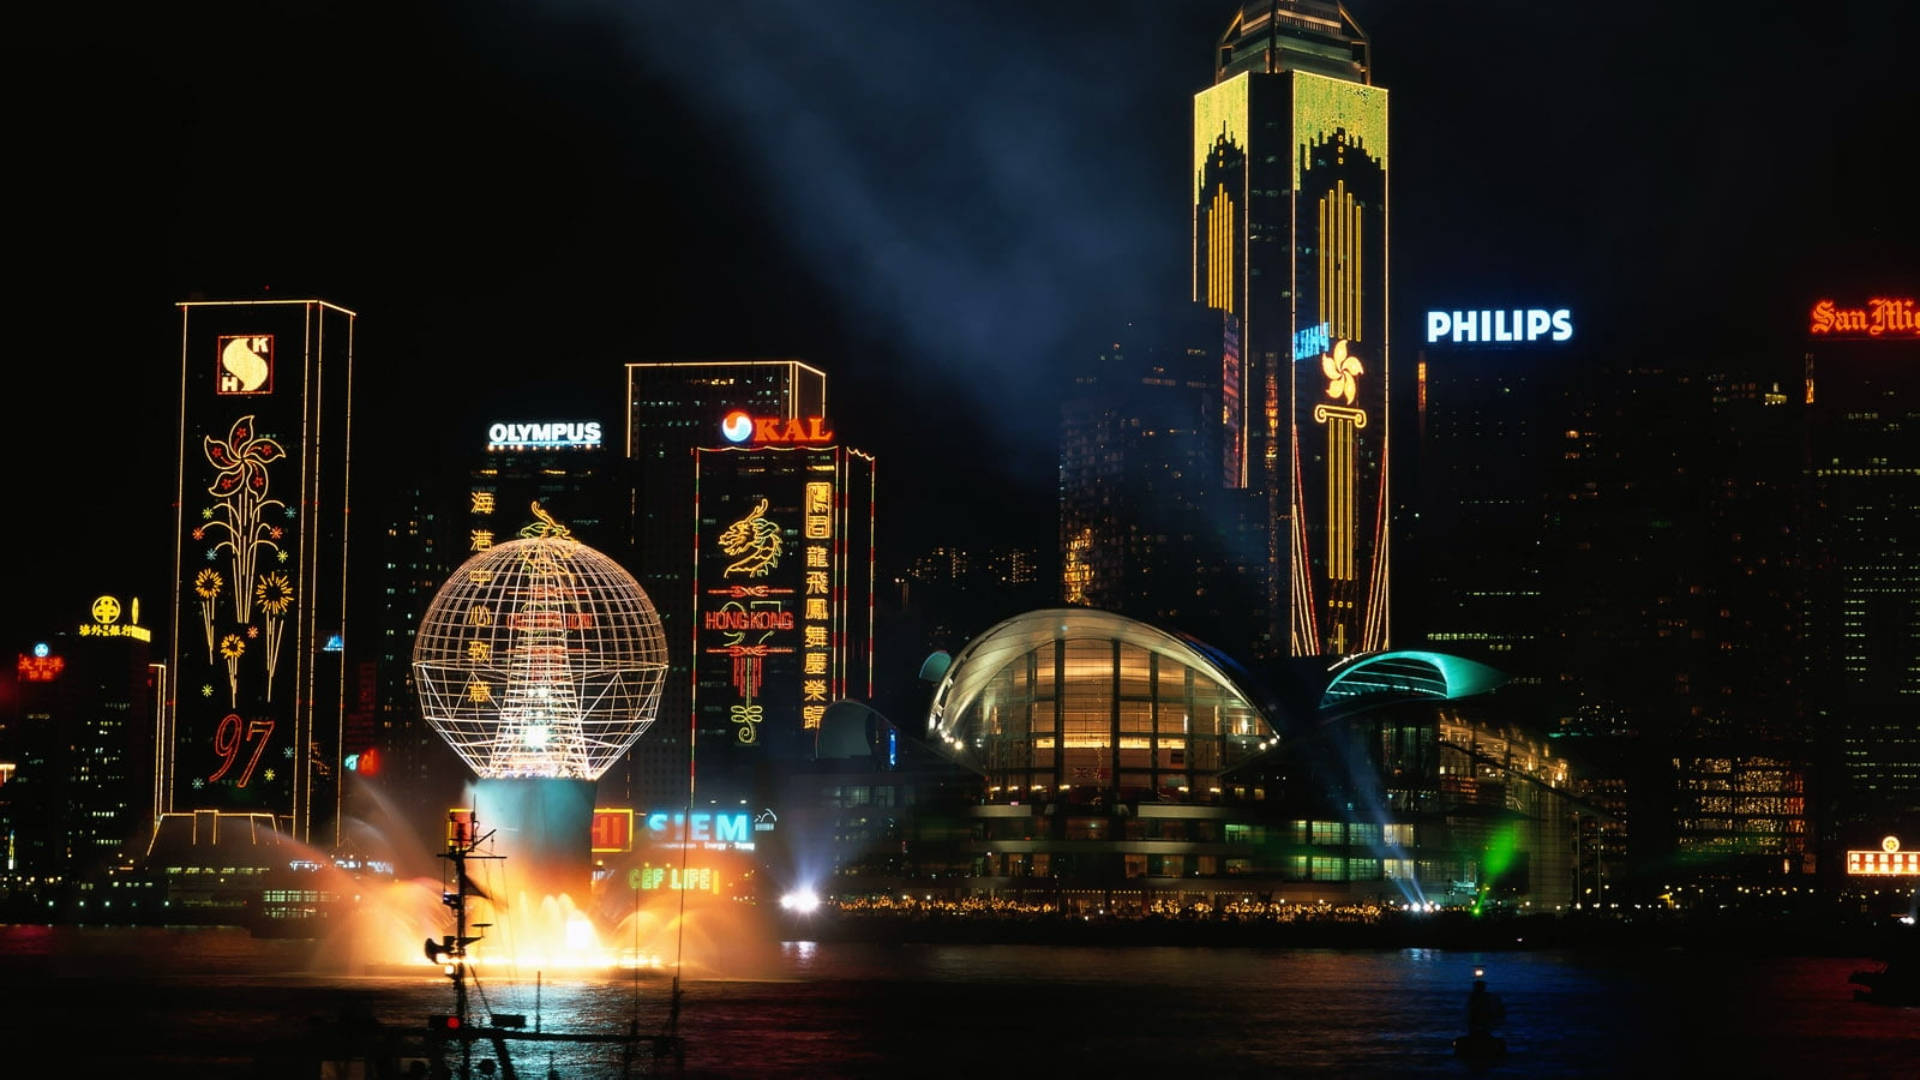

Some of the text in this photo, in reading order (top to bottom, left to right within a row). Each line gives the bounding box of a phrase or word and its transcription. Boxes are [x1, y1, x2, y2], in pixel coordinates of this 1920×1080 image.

[1427, 309, 1573, 342] PHILIPS
[1811, 300, 1869, 333] San
[489, 422, 602, 442] OLYMPUS
[754, 416, 833, 442] KAL
[705, 611, 795, 630] HONG KONG
[208, 713, 275, 788] 97
[669, 867, 711, 890] LIFE
